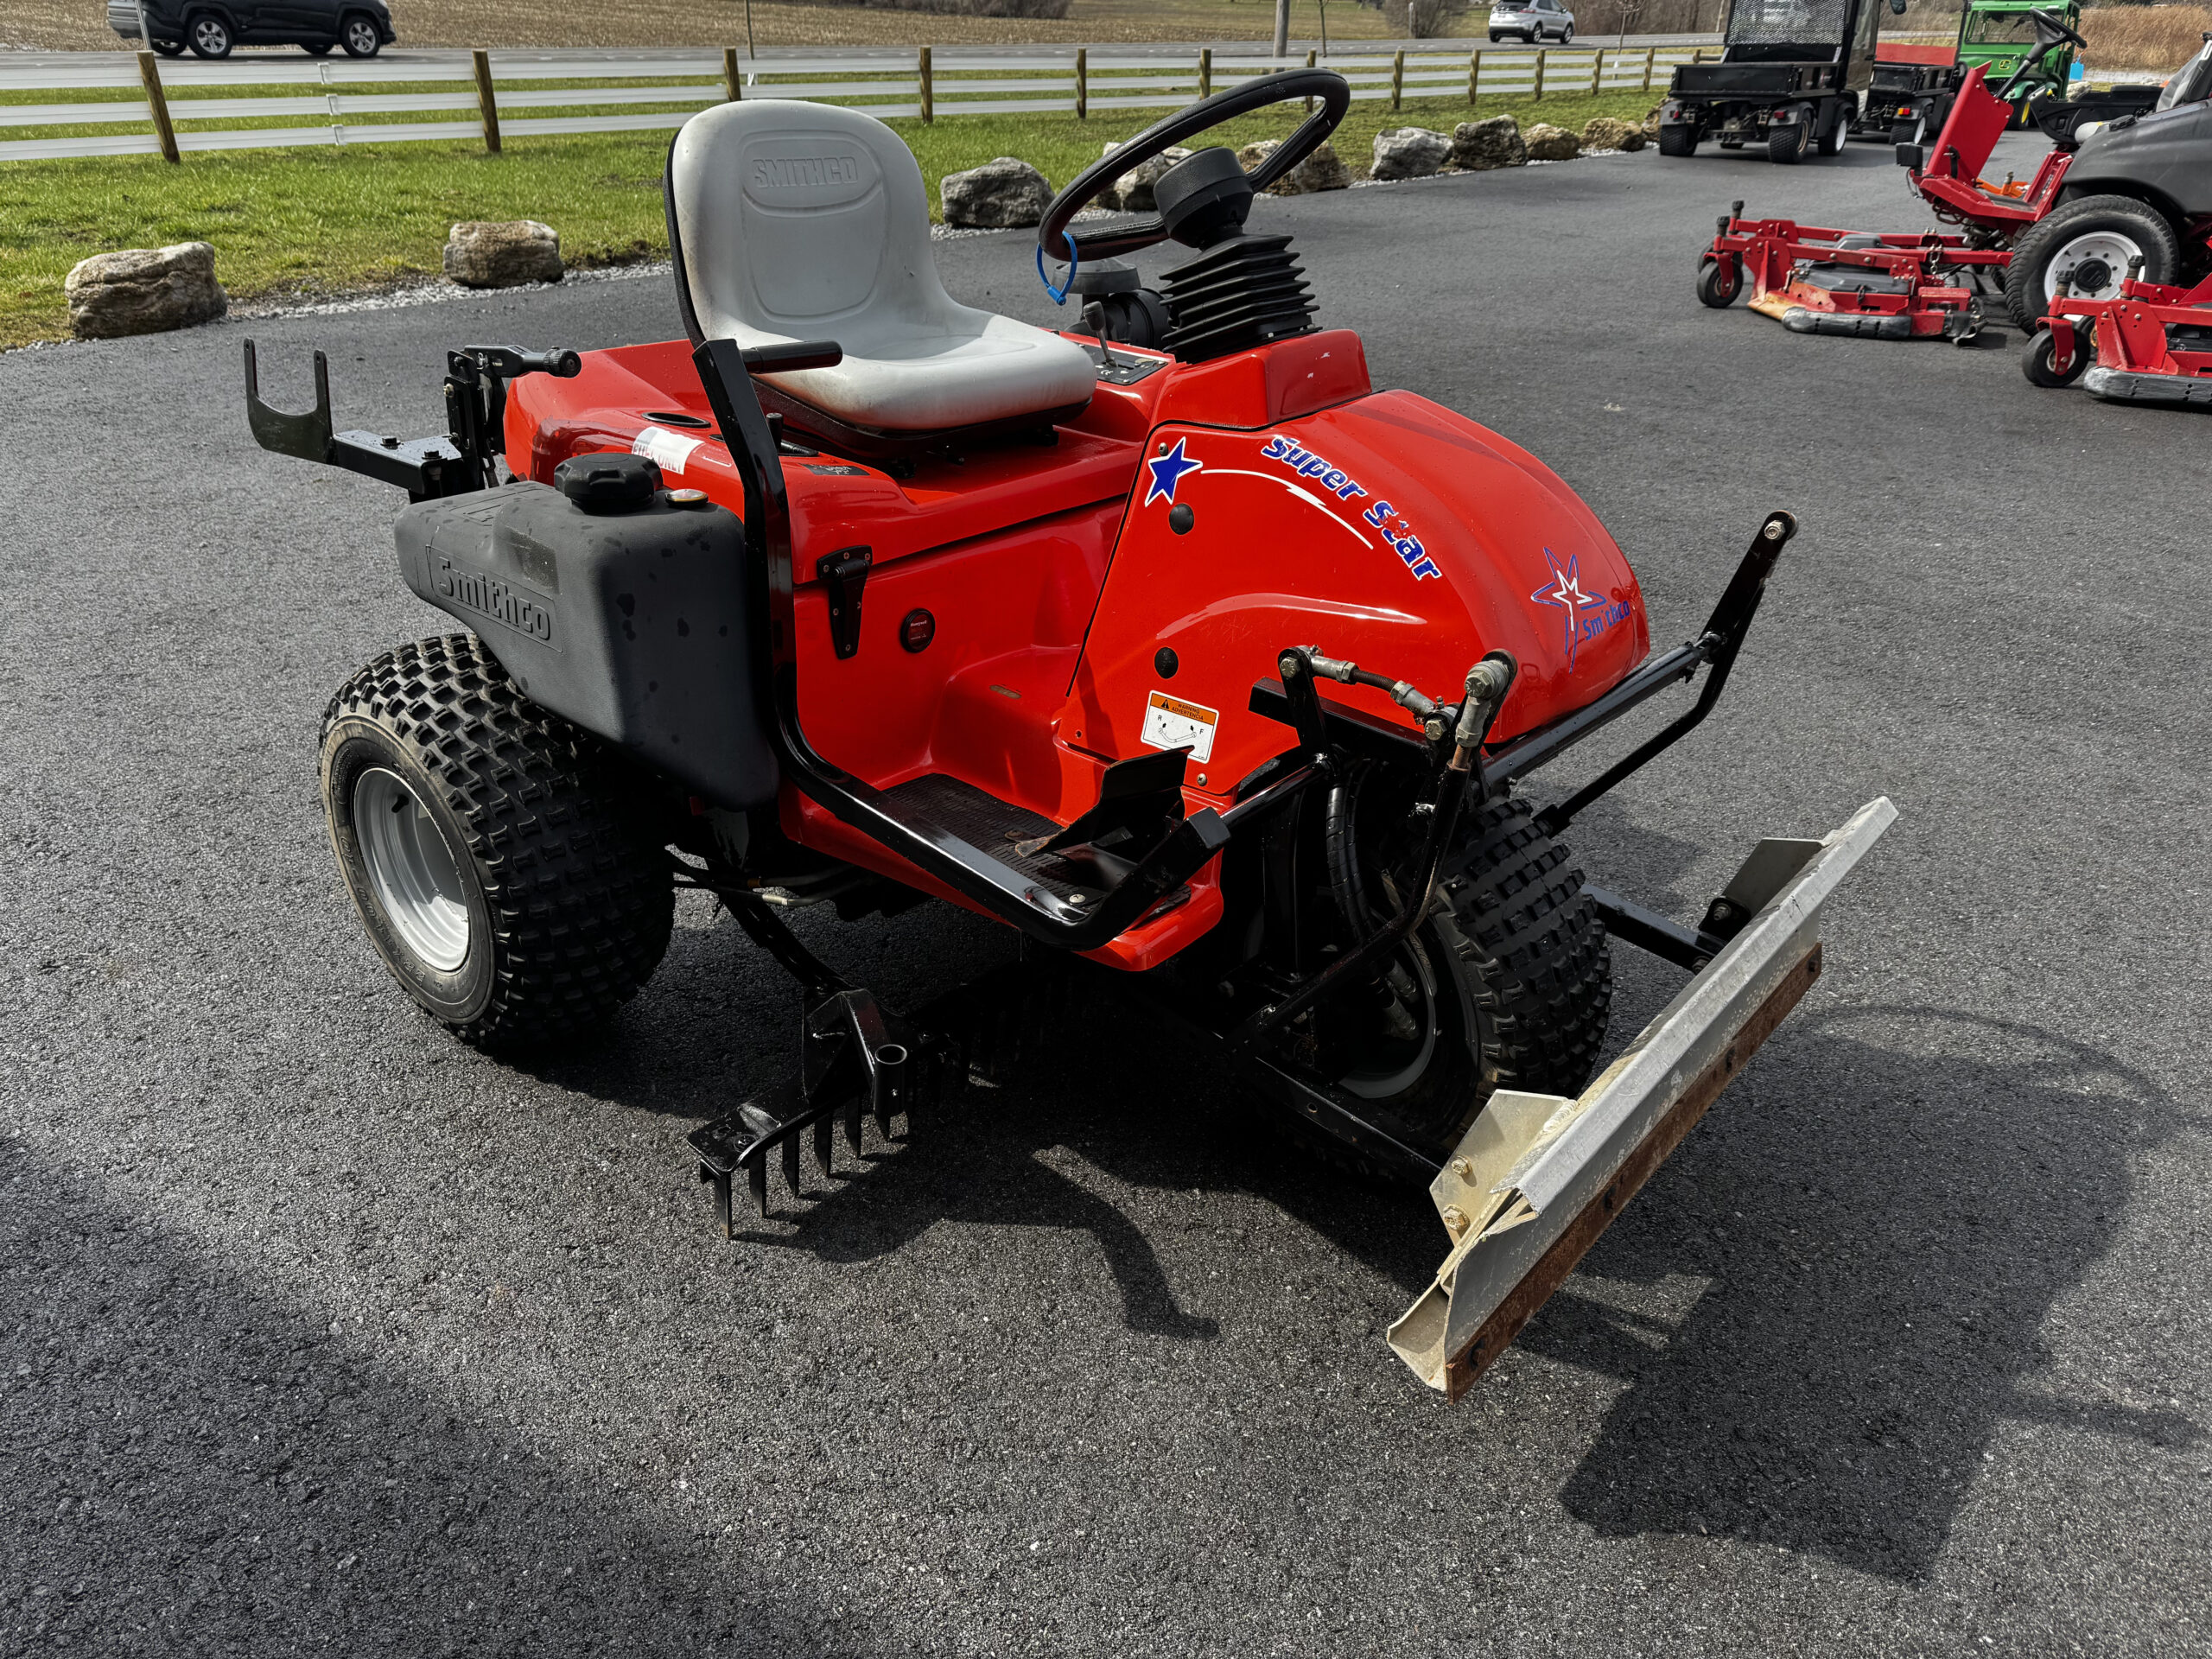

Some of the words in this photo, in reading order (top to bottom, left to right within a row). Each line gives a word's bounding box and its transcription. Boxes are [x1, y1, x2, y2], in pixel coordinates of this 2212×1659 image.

[753, 156, 858, 188] SMITHCO
[1261, 435, 1369, 501] Super
[438, 556, 550, 640] Smithco
[1582, 600, 1630, 641] Smthco
[1172, 707, 1204, 721] ADVERTENCIA
[1178, 703, 1200, 715] WARNING
